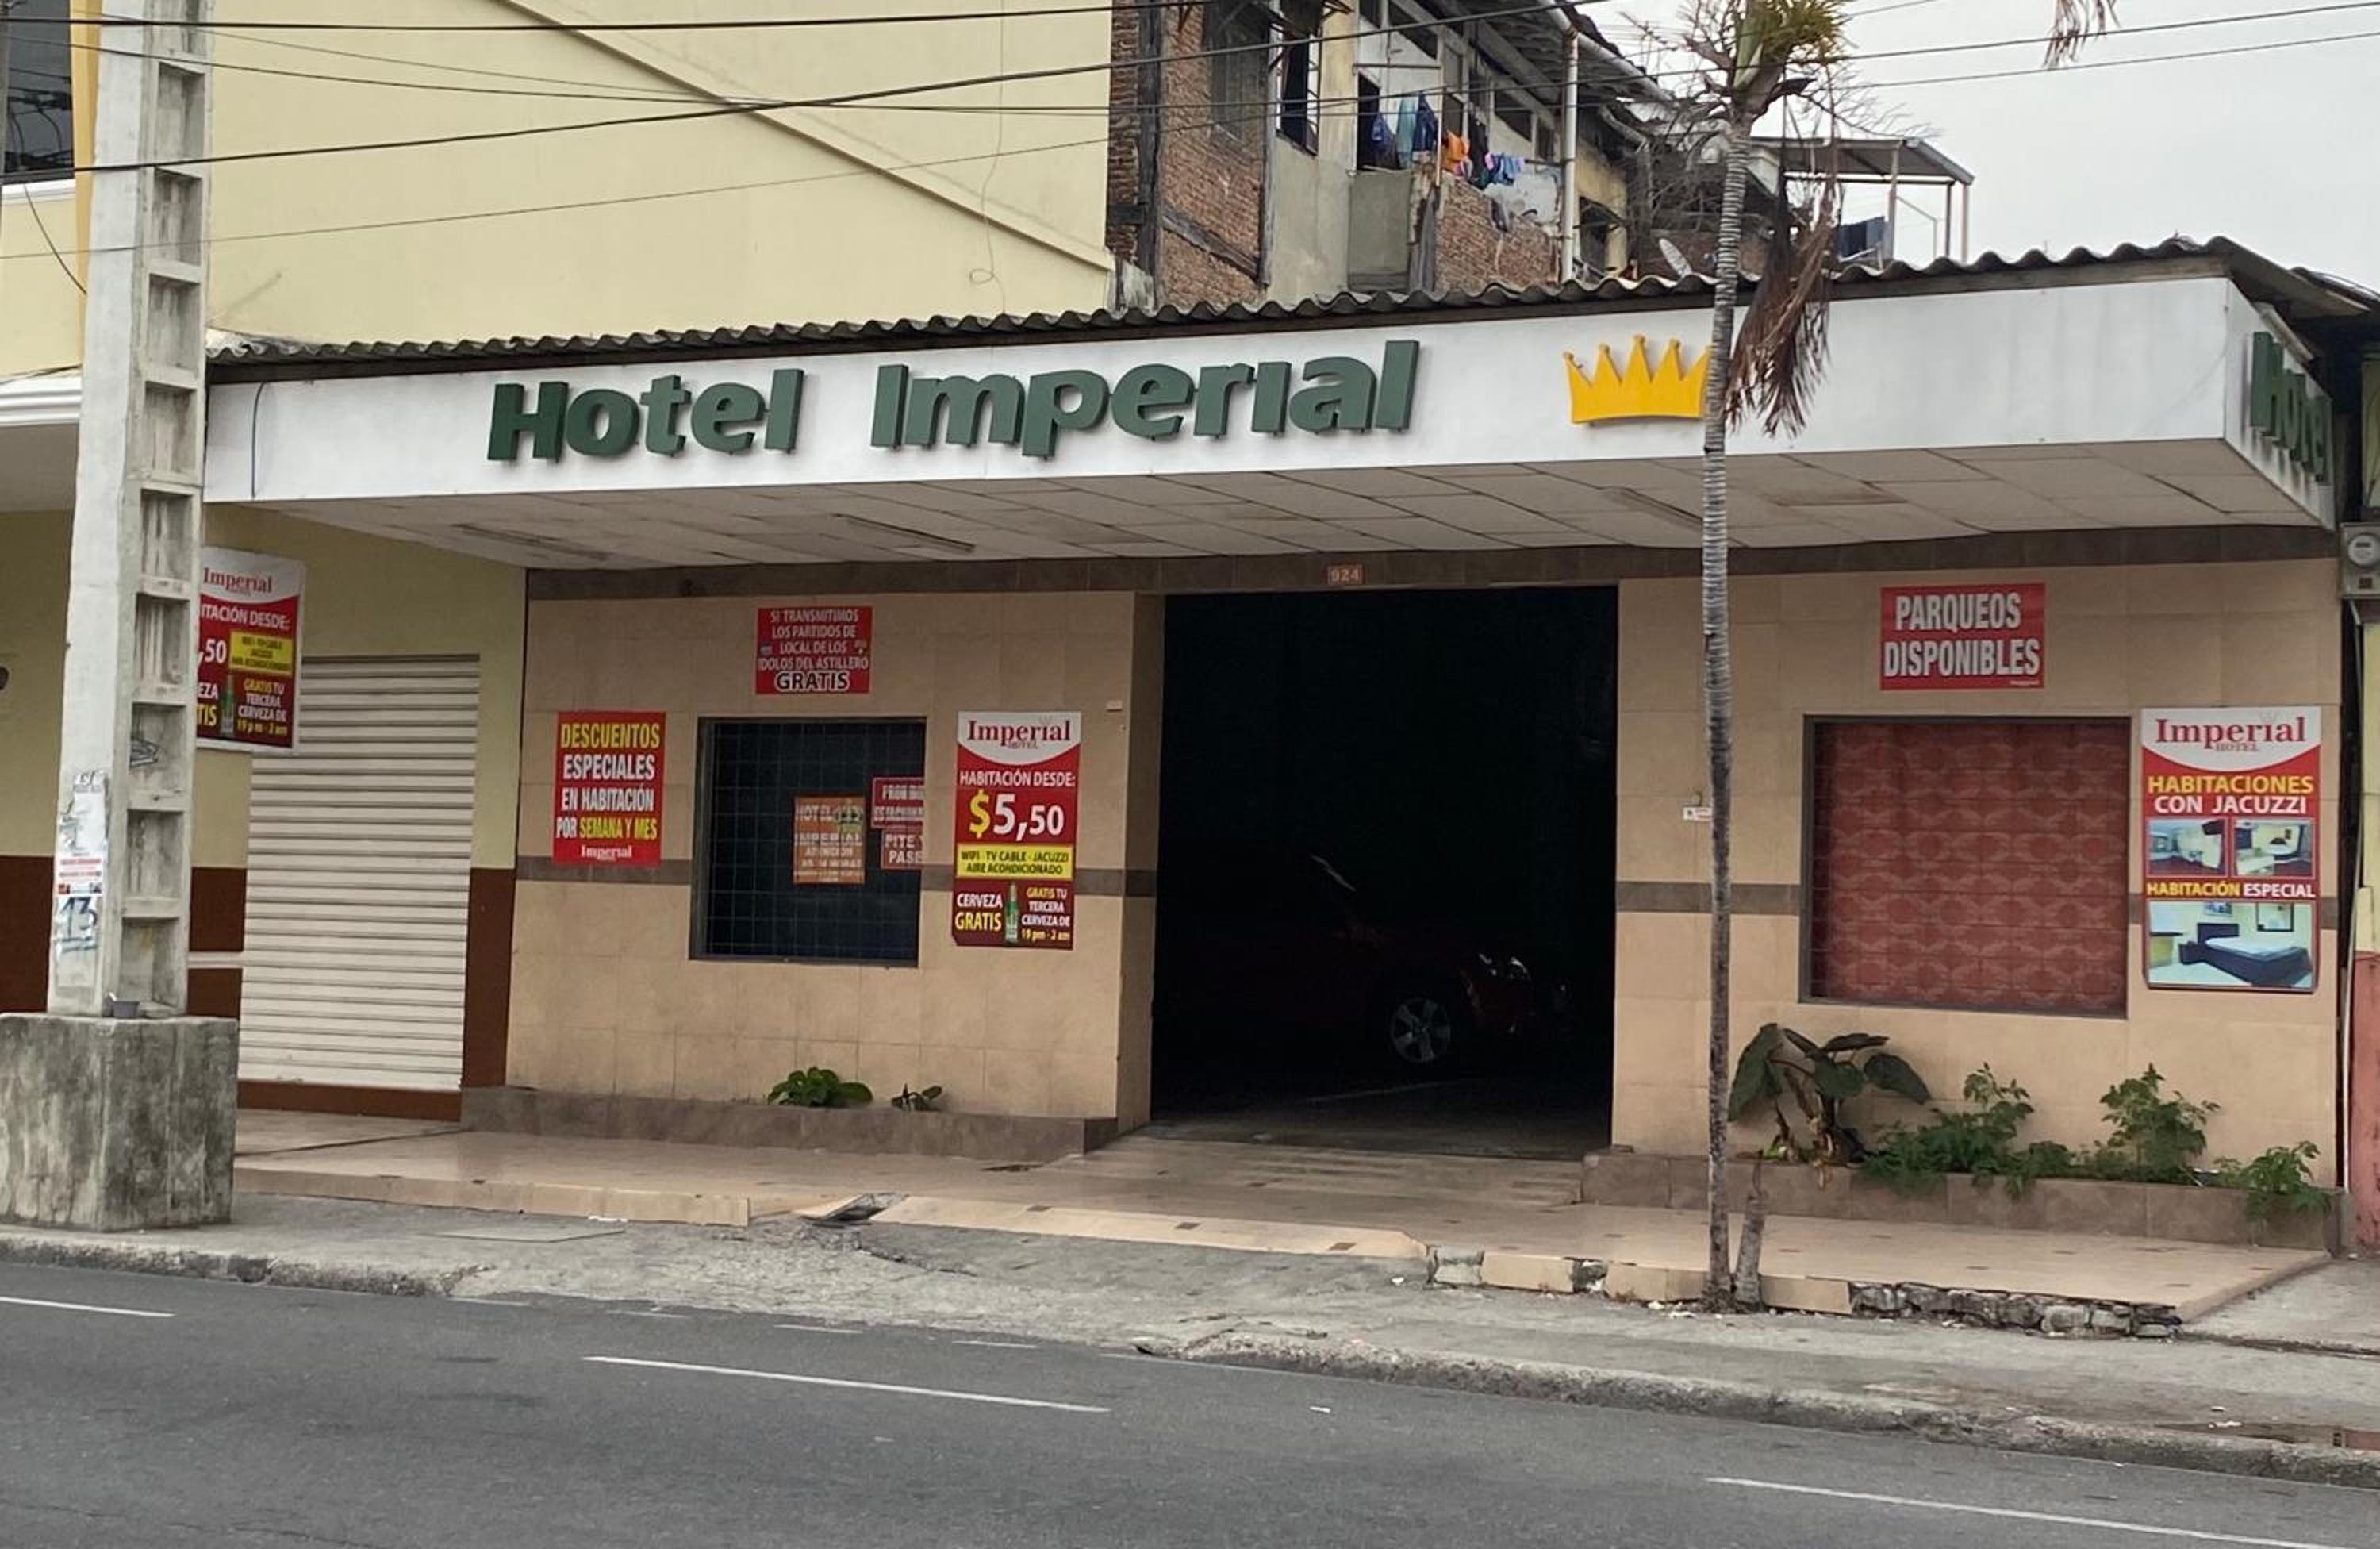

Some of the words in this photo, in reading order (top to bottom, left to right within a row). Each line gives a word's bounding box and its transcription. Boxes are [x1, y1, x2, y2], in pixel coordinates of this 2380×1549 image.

[487, 368, 804, 463] Hotel
[870, 340, 1420, 459] Imperial
[203, 567, 272, 593] Imperial
[200, 604, 248, 624] ITACIÓN
[1895, 592, 2021, 633] PARQUEOS
[772, 625, 790, 639] LOS
[793, 625, 841, 638] PARTIDOS
[843, 625, 857, 637] DE
[780, 640, 810, 654] LOCAL
[813, 640, 827, 654] DE
[828, 640, 846, 654] LOS
[796, 657, 813, 670] DEL
[815, 656, 869, 670] ASTILLERO
[1883, 639, 2040, 677] DISPONIBLES
[775, 671, 850, 691] GRATIS
[560, 723, 660, 748] DESCUENTOS
[967, 720, 1069, 747] Imperial
[2155, 717, 2305, 749] Imperial
[563, 754, 655, 780] ESPECIALES
[959, 769, 1031, 786] HABITACIÓN
[1033, 771, 1076, 786] DESDE:
[2148, 776, 2314, 794] HABITACIONES
[562, 787, 578, 811] EN
[582, 782, 654, 811] HABITACIÓN
[2155, 796, 2202, 813] CON
[2212, 796, 2306, 813] JACUZZI
[556, 817, 578, 839] POR
[579, 817, 623, 839] SEMANA
[624, 817, 633, 838] Y
[635, 817, 658, 840] MES
[582, 844, 632, 860] Imperial
[962, 850, 981, 861] WIFI
[986, 851, 997, 861] TV
[999, 851, 1026, 862] CABLE
[1033, 851, 1069, 863] JACUZZI
[965, 863, 985, 873] AIRE
[987, 863, 1063, 874] ACONDICIONADO
[1027, 886, 1055, 898] GRATIS
[1056, 888, 1067, 900] TU
[2147, 881, 2240, 896] HABITACIÓN
[2243, 883, 2316, 897] ESPECIAL
[956, 894, 1003, 909] CERVEZA
[1029, 901, 1065, 913] TERCERA
[955, 913, 1002, 932] GRATIS
[1021, 914, 1058, 926] CERVEZA
[1059, 916, 1070, 927] DE
